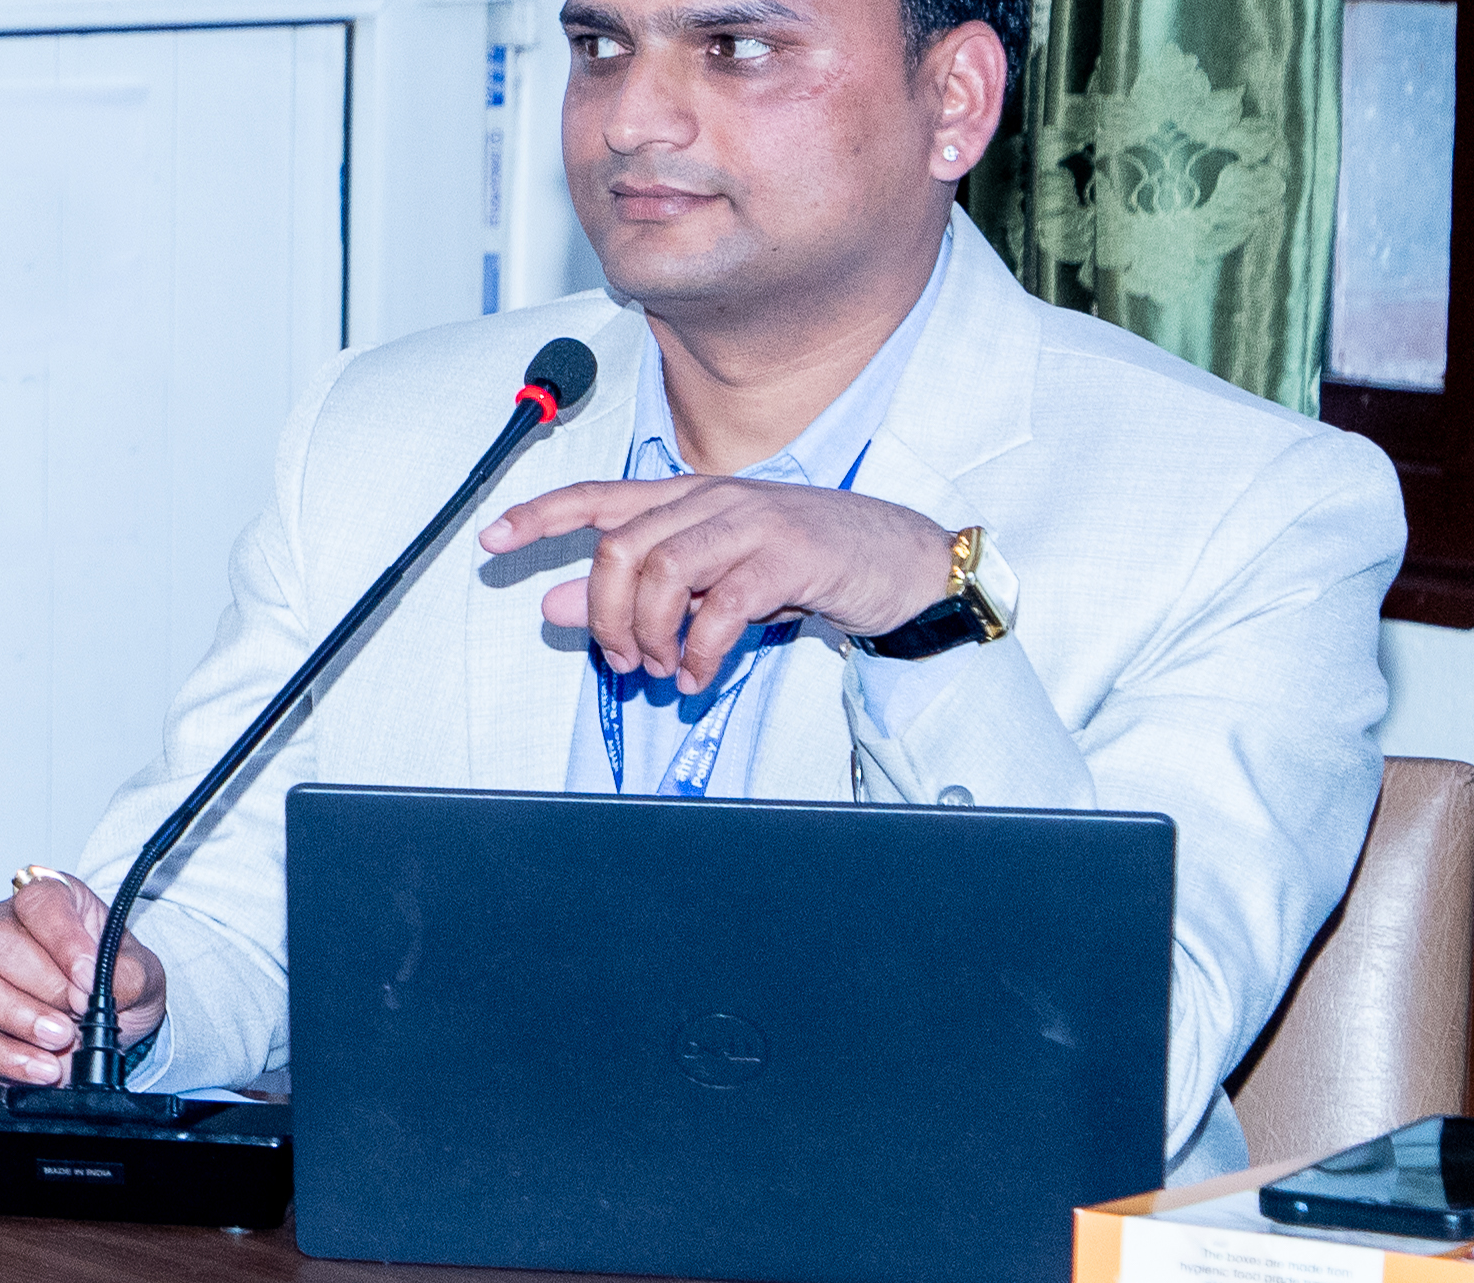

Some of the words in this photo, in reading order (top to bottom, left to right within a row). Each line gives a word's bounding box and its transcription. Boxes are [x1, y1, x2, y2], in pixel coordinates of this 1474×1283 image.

[692, 741, 718, 787] Policy
[42, 1166, 72, 1176] MADE
[1226, 1252, 1262, 1267] boxes
[1288, 1261, 1324, 1275] made
[1327, 1265, 1354, 1279] from
